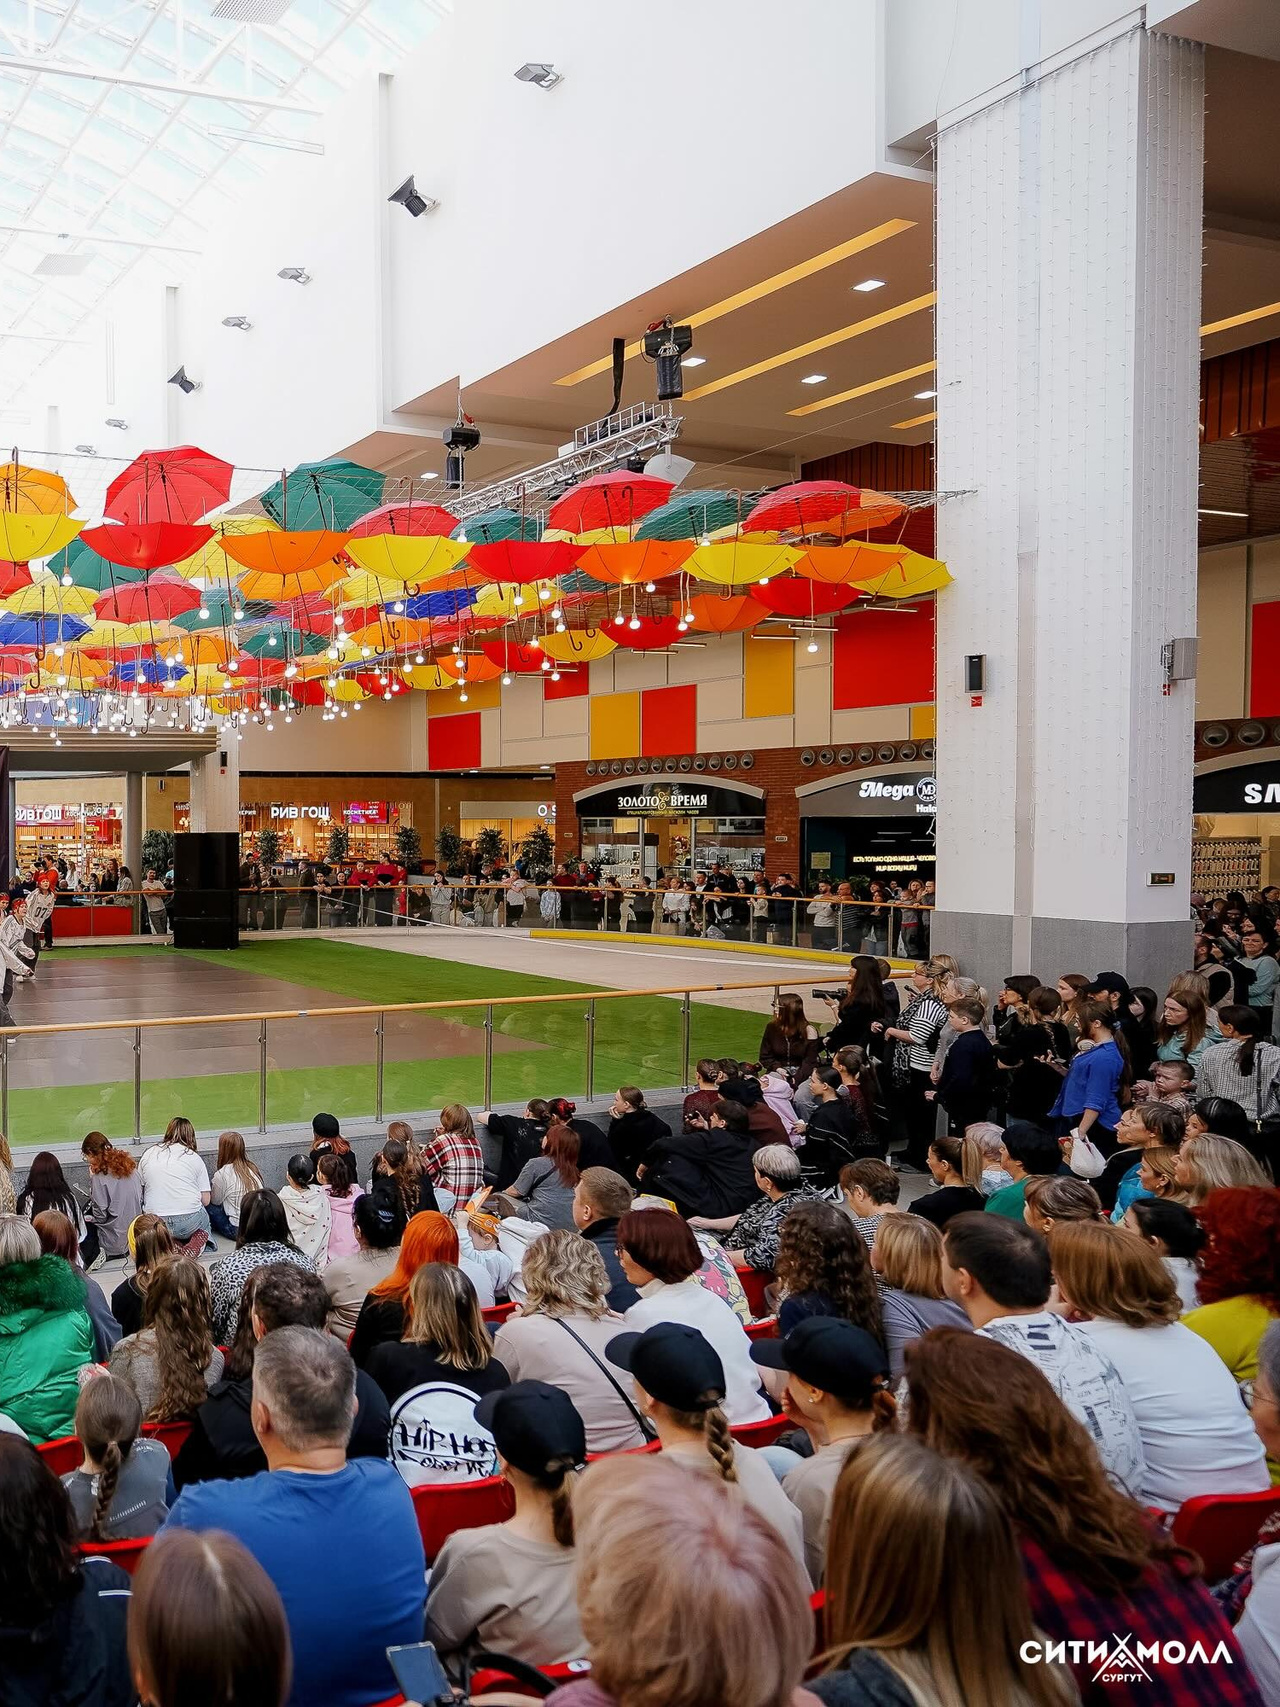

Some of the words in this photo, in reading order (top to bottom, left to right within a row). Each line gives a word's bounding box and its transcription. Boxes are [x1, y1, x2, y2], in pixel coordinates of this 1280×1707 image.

[859, 781, 915, 801] Mega
[617, 796, 659, 807] ЗОЛОТО
[670, 794, 708, 806] ВРЕМЯ
[271, 806, 299, 819] РИВ
[301, 806, 329, 819] ГОШ
[34, 906, 48, 918] 07
